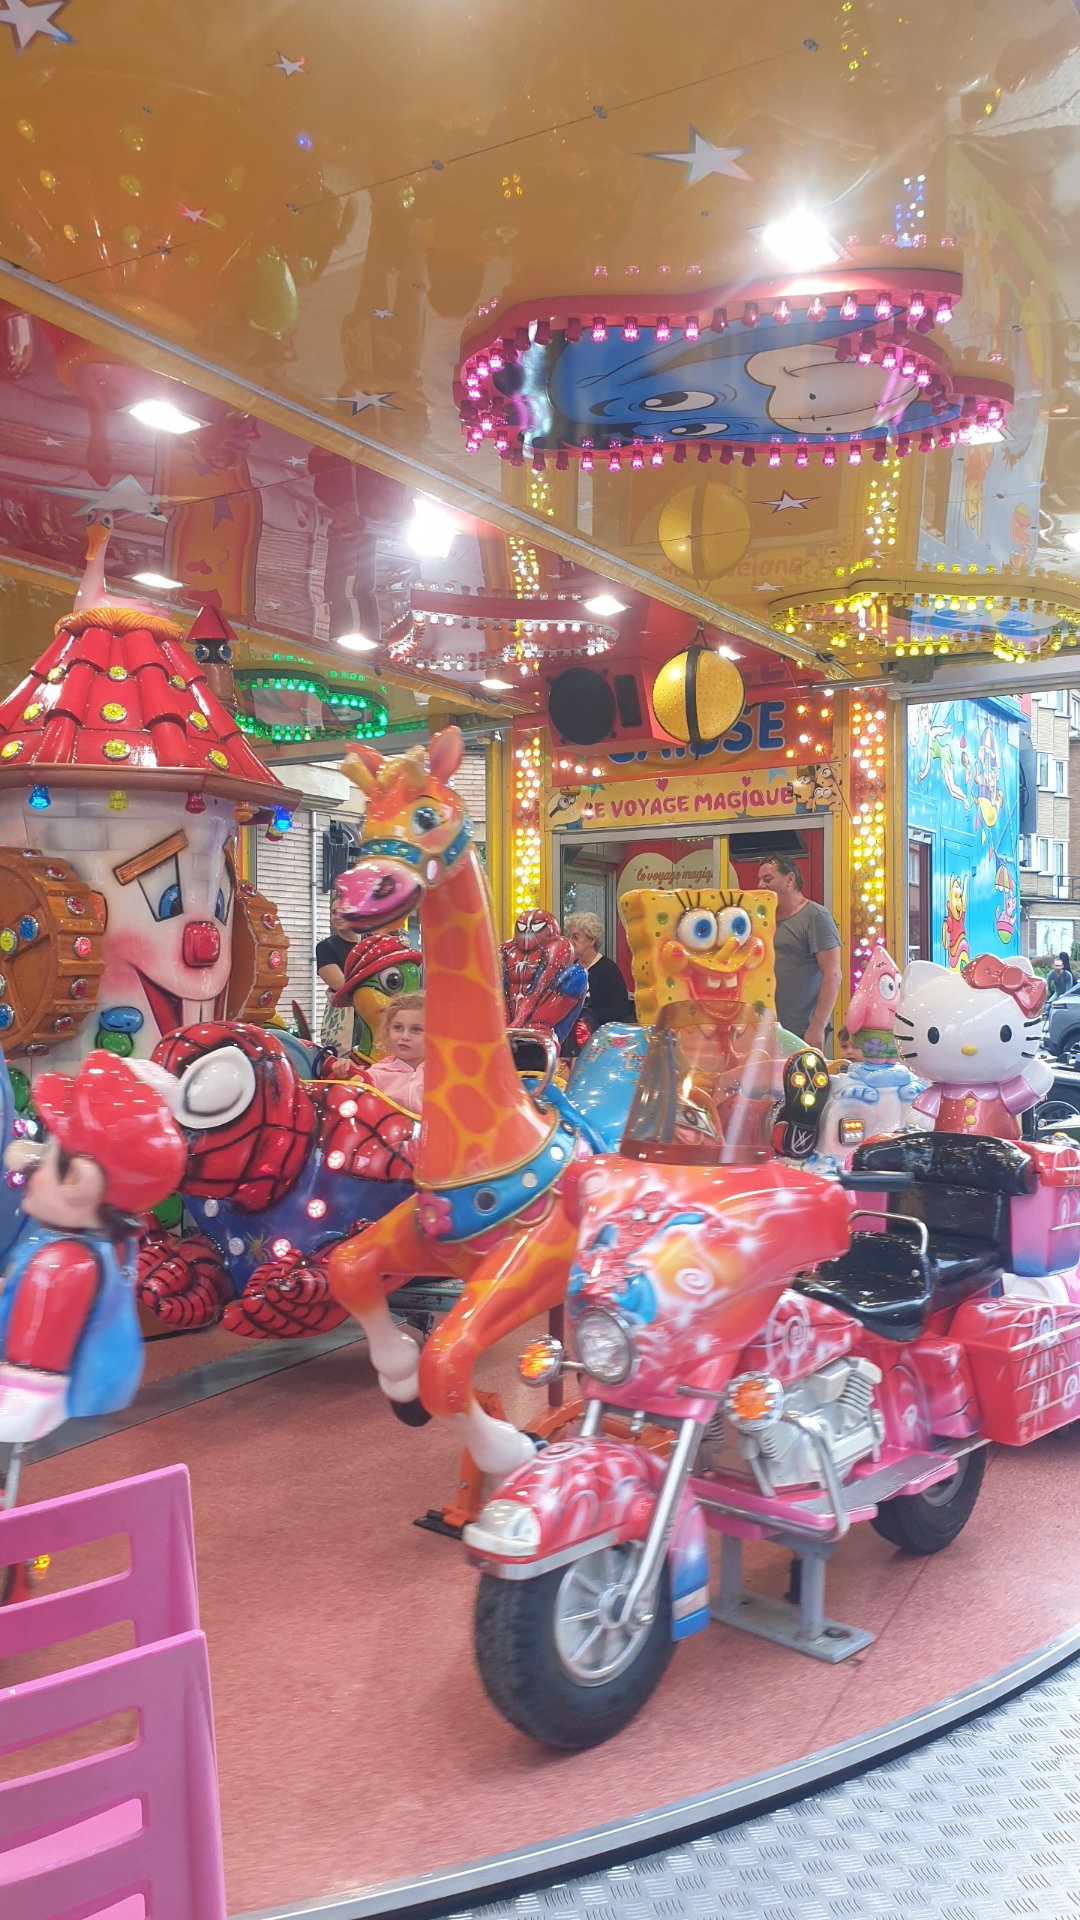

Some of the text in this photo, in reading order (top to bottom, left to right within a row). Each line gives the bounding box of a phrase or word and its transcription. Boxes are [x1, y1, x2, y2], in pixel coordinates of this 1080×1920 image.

[610, 795, 690, 818] VOYAGE
[694, 785, 795, 812] MAGIQUE
[637, 867, 713, 886] le voyage magiq
